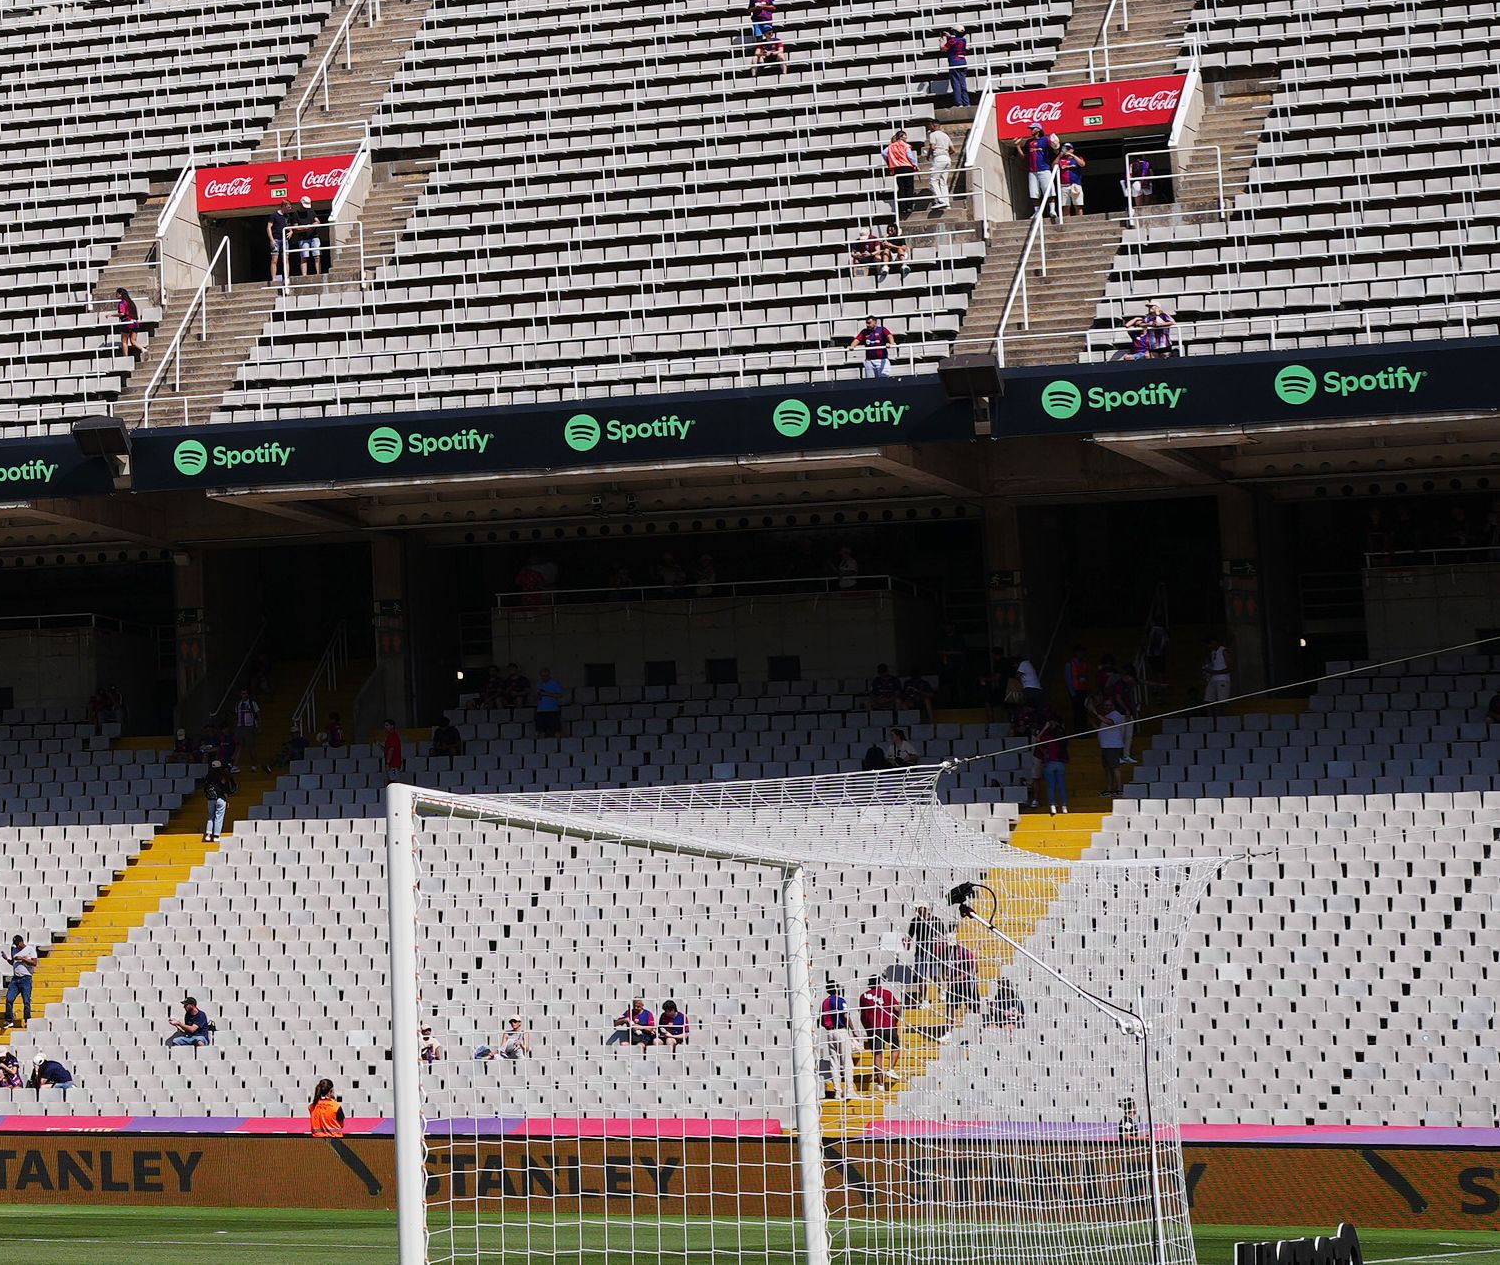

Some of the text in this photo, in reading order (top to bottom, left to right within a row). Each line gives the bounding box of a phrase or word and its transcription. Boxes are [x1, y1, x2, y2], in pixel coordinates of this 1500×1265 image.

[1006, 101, 1065, 125] Coca-Cola
[1121, 89, 1181, 114] Coca-Cola
[204, 176, 253, 198] Coca-Cola
[302, 167, 349, 190] Coca-Col
[1324, 366, 1427, 396] Spotify
[1088, 383, 1187, 411] Spotify
[817, 401, 910, 429] Spotify
[607, 415, 694, 443] Spotify
[213, 442, 292, 468] Spotify
[409, 430, 490, 455] Spotify
